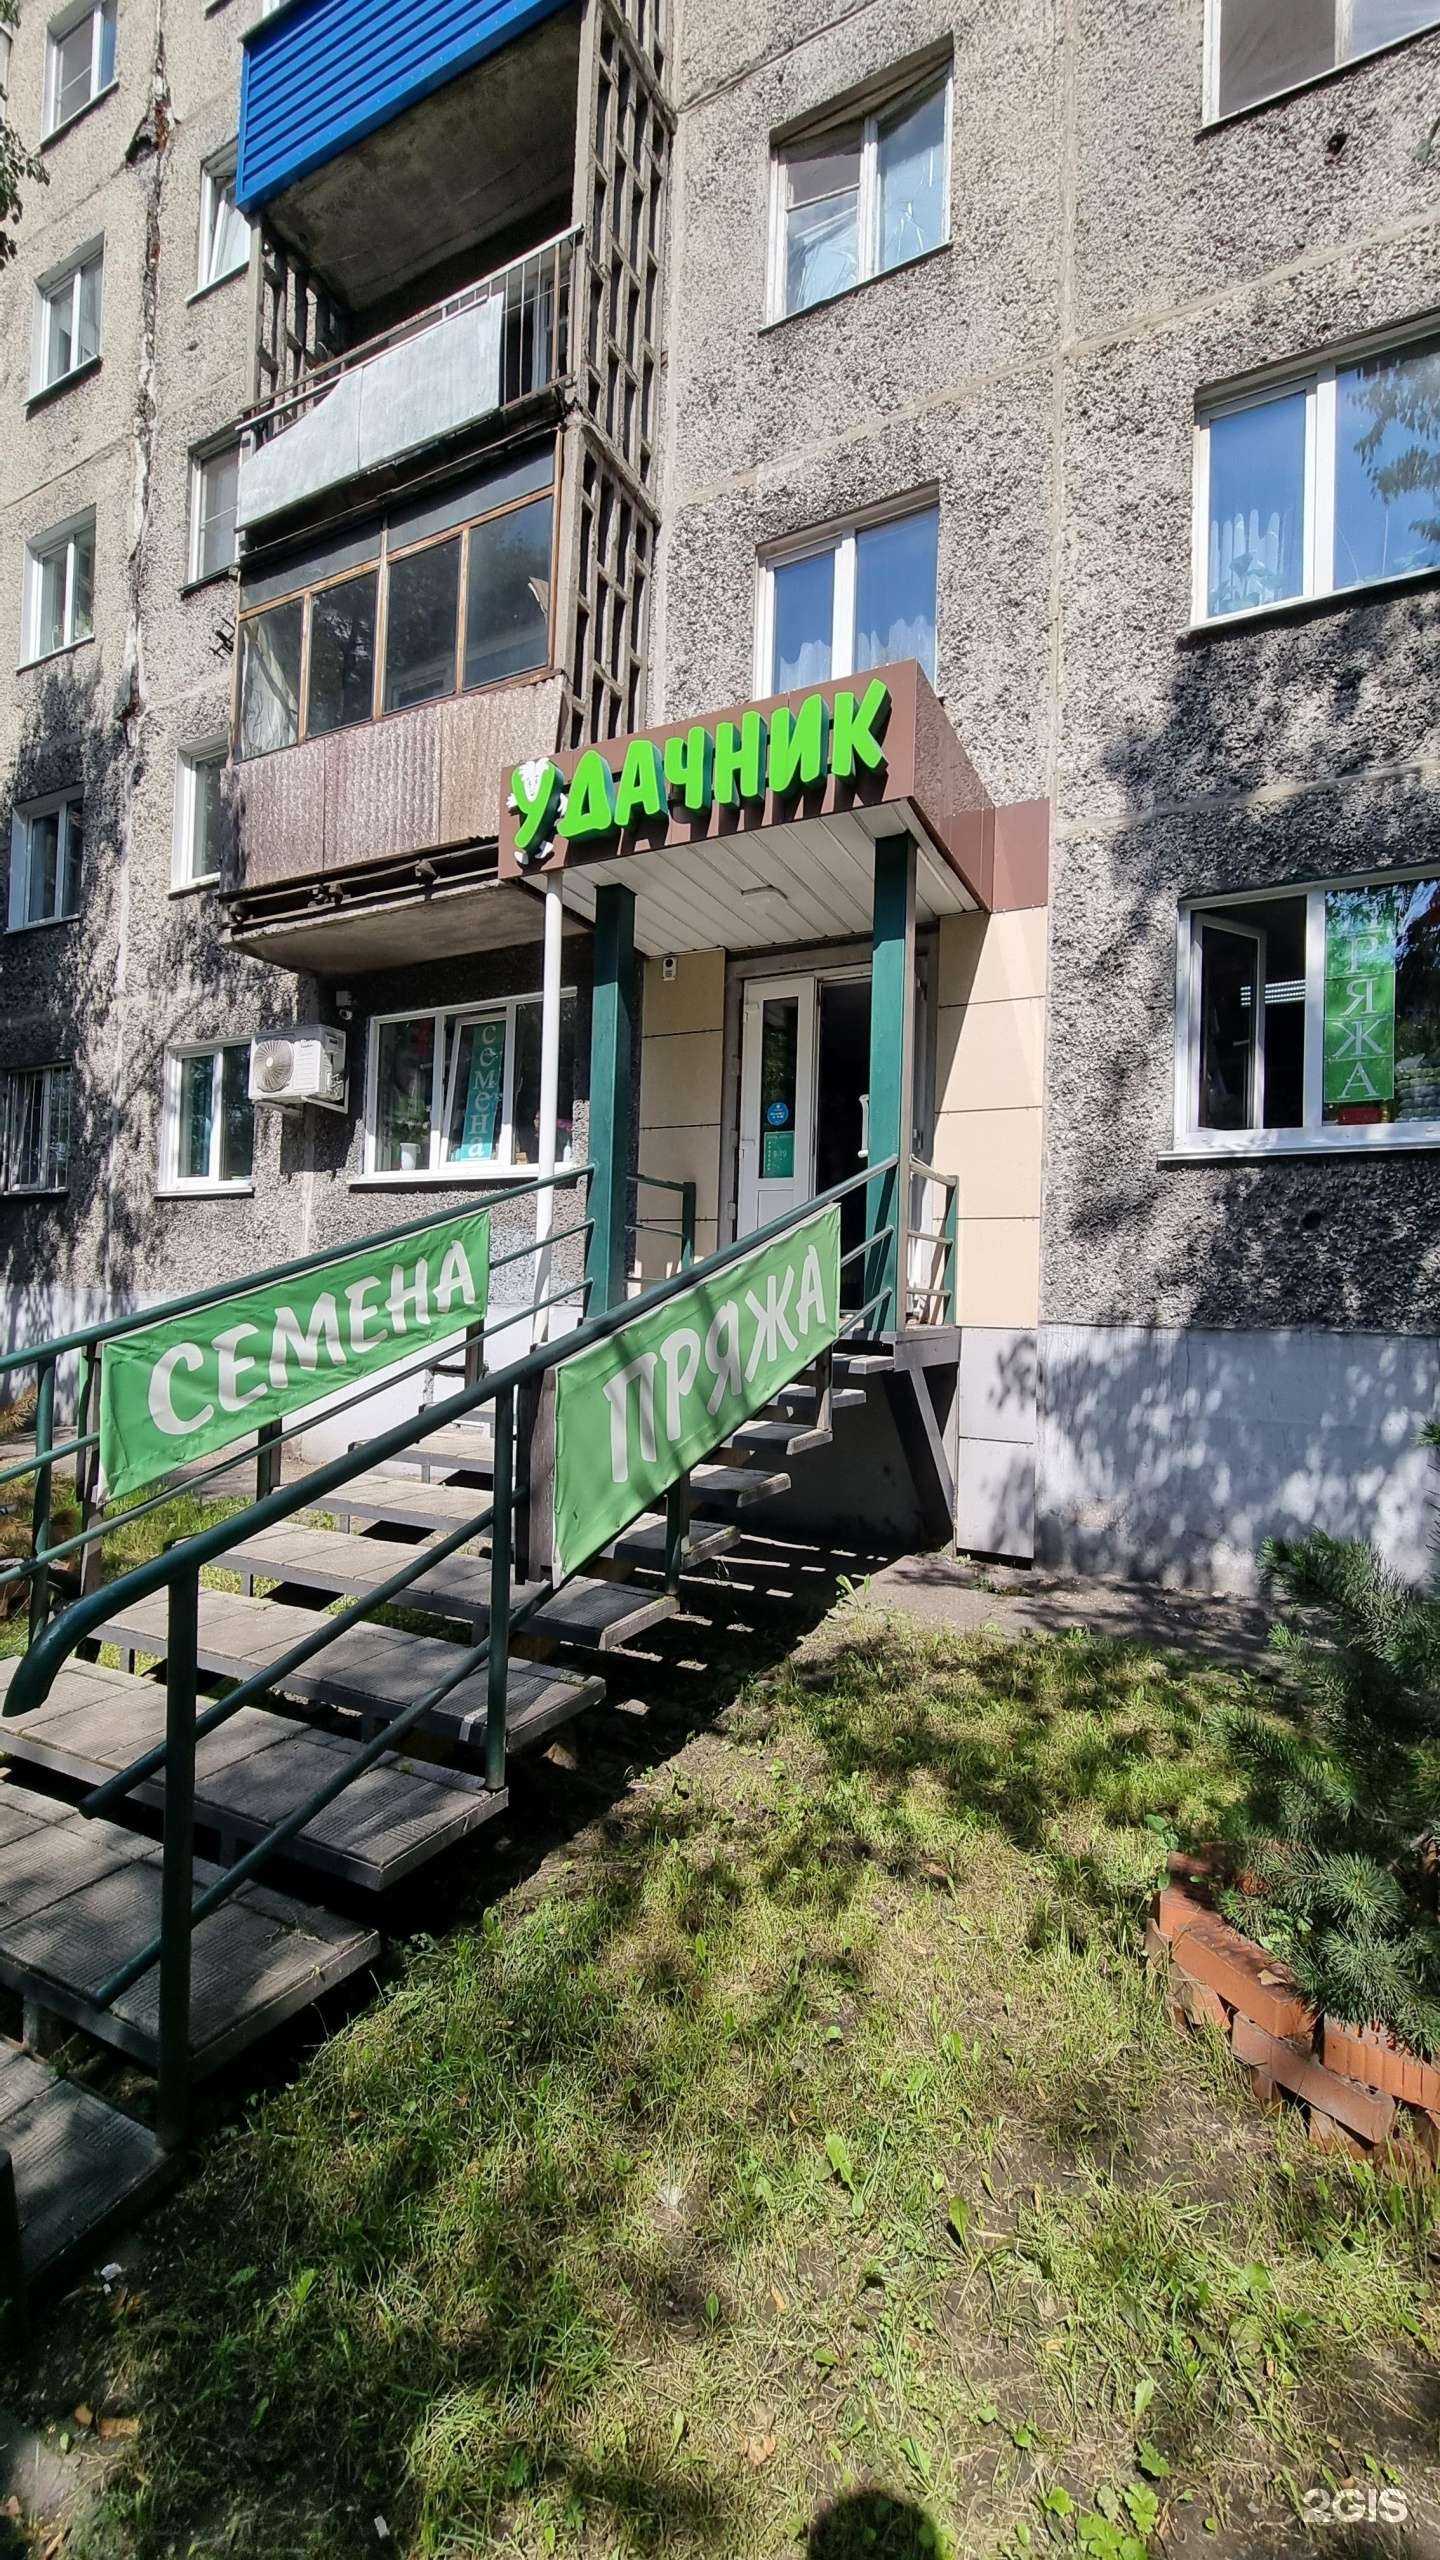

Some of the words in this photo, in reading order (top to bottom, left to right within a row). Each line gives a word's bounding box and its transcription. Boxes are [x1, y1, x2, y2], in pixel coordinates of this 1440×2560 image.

[511, 678, 890, 850] УДАЧНИК
[148, 1239, 475, 1436] СЕМЕНА
[601, 1243, 827, 1482] ПРЯЖА
